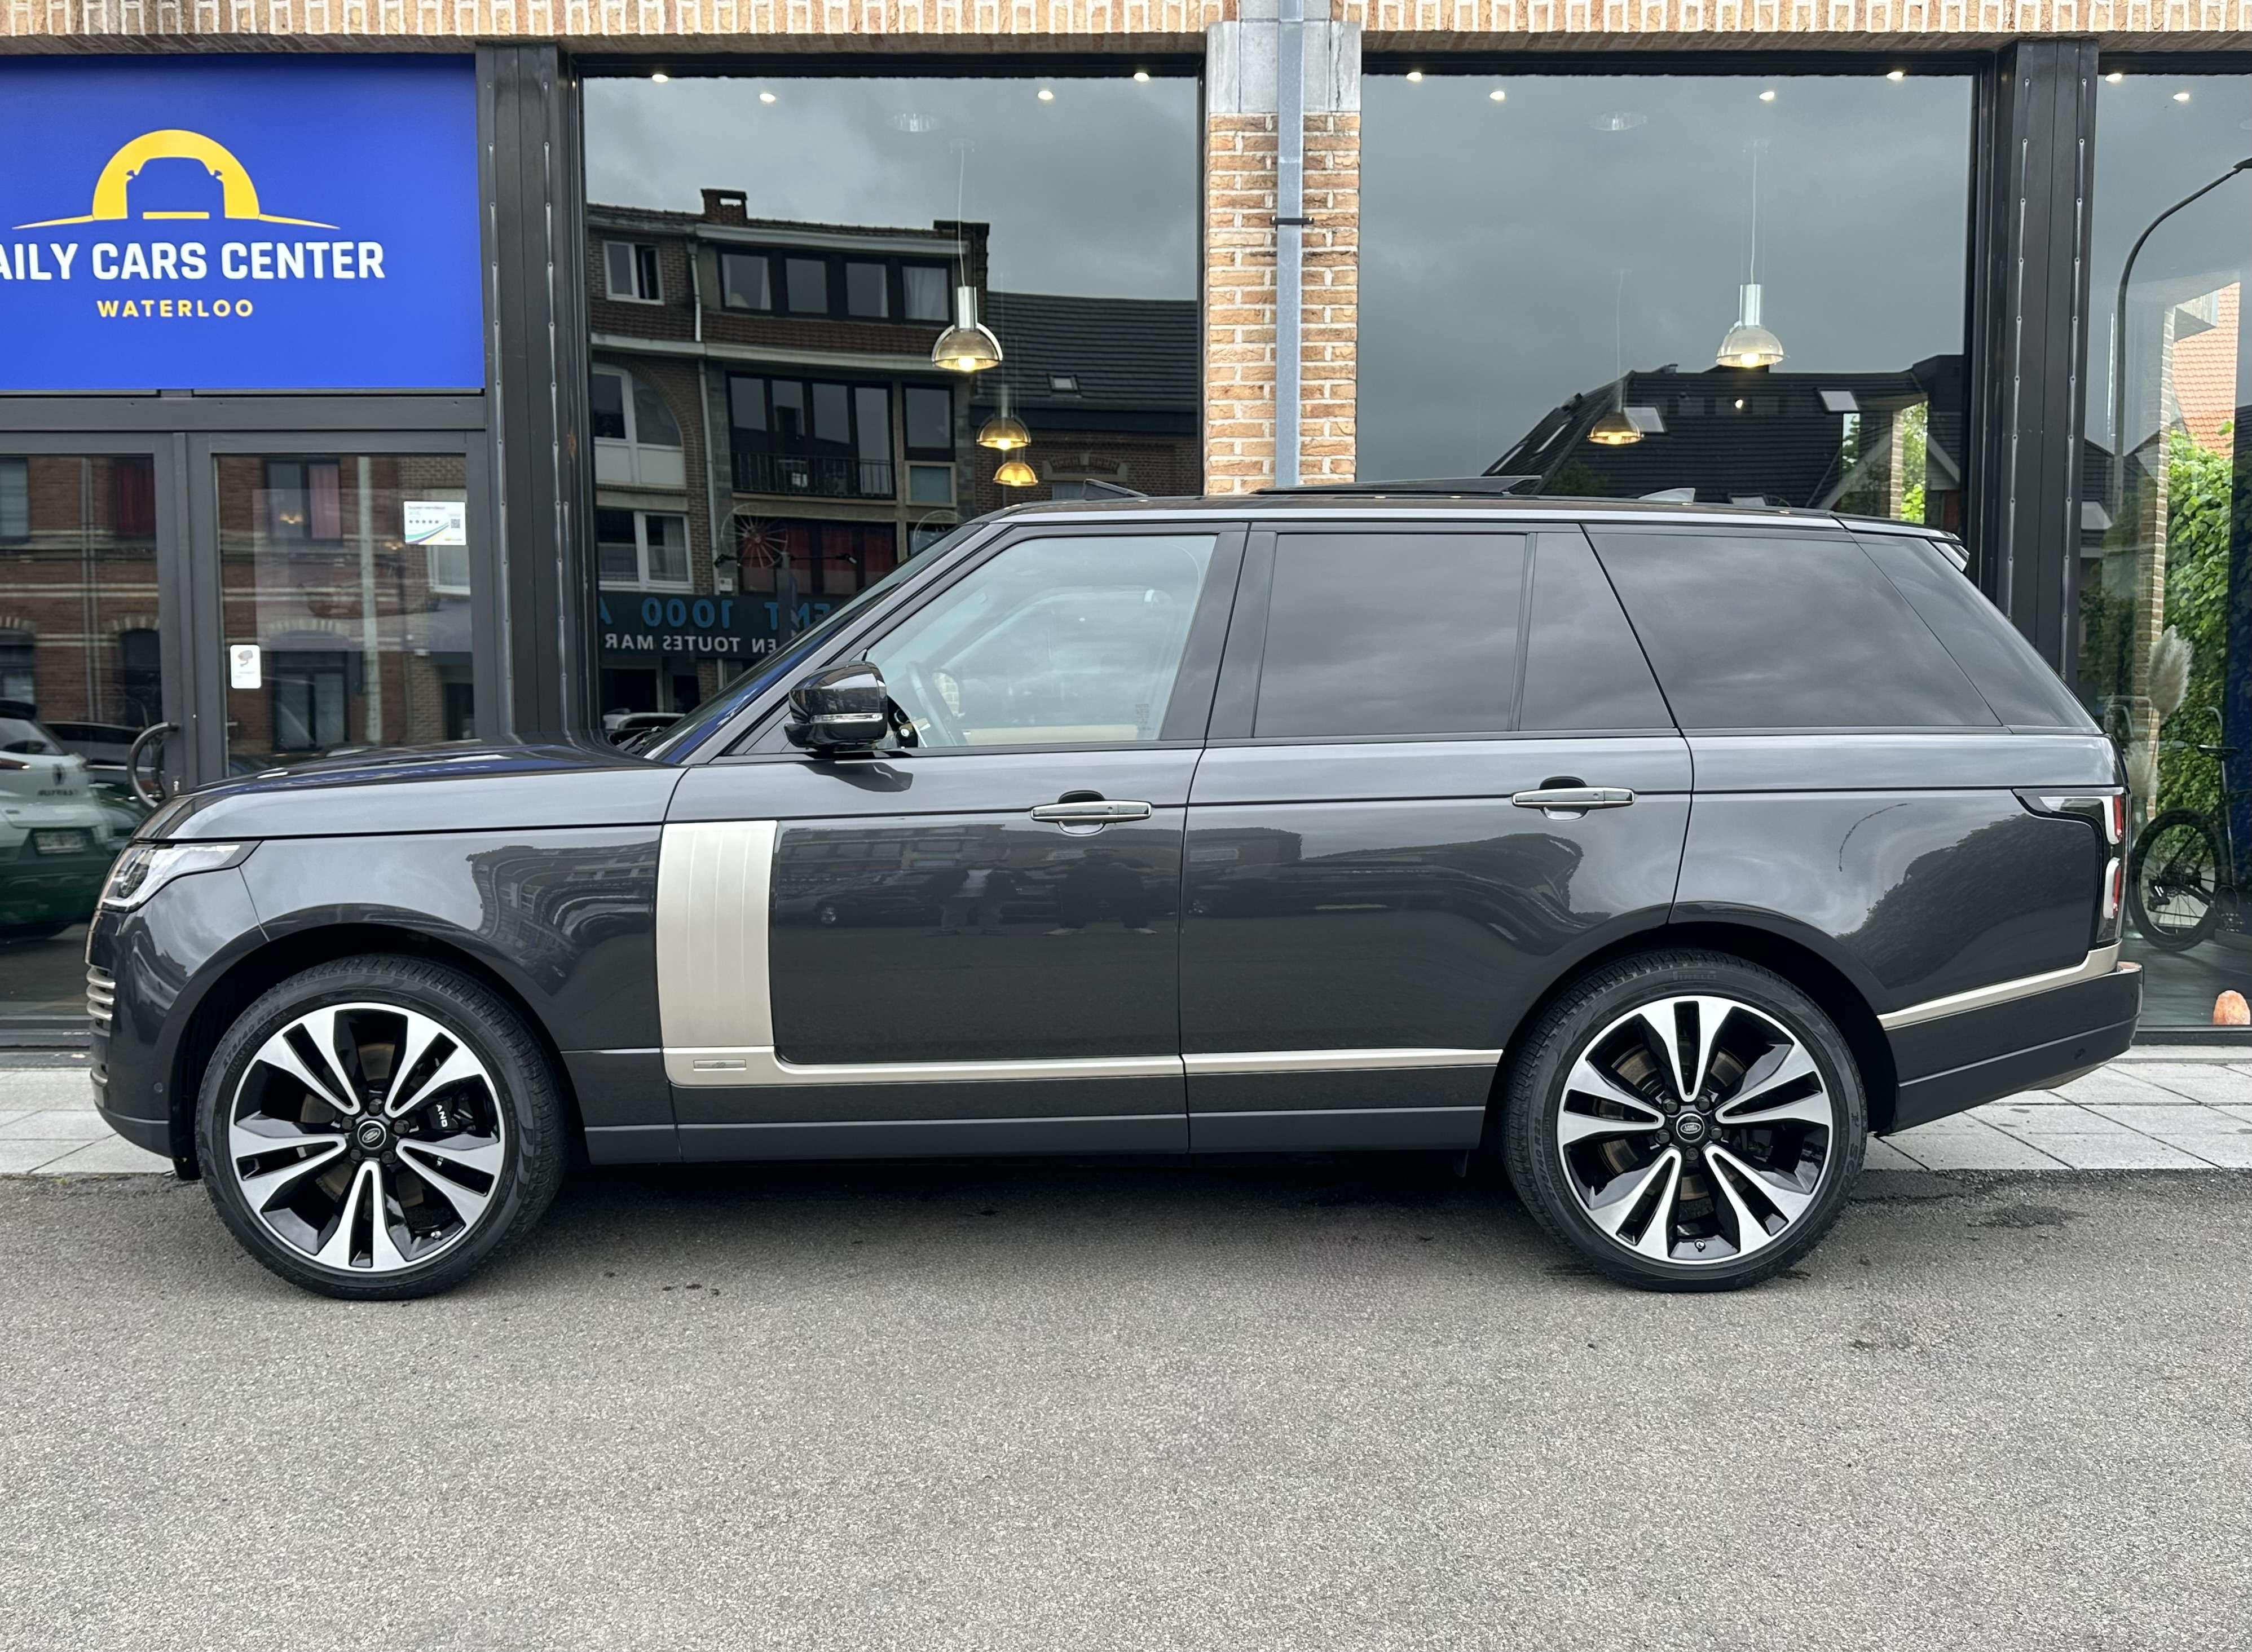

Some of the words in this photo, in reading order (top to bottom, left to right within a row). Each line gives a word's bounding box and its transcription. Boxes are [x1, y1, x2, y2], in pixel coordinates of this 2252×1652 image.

[92, 242, 207, 280] CARS
[222, 241, 385, 280] CENTER
[97, 299, 253, 317] WATERLOO
[436, 1104, 448, 1128] AND
